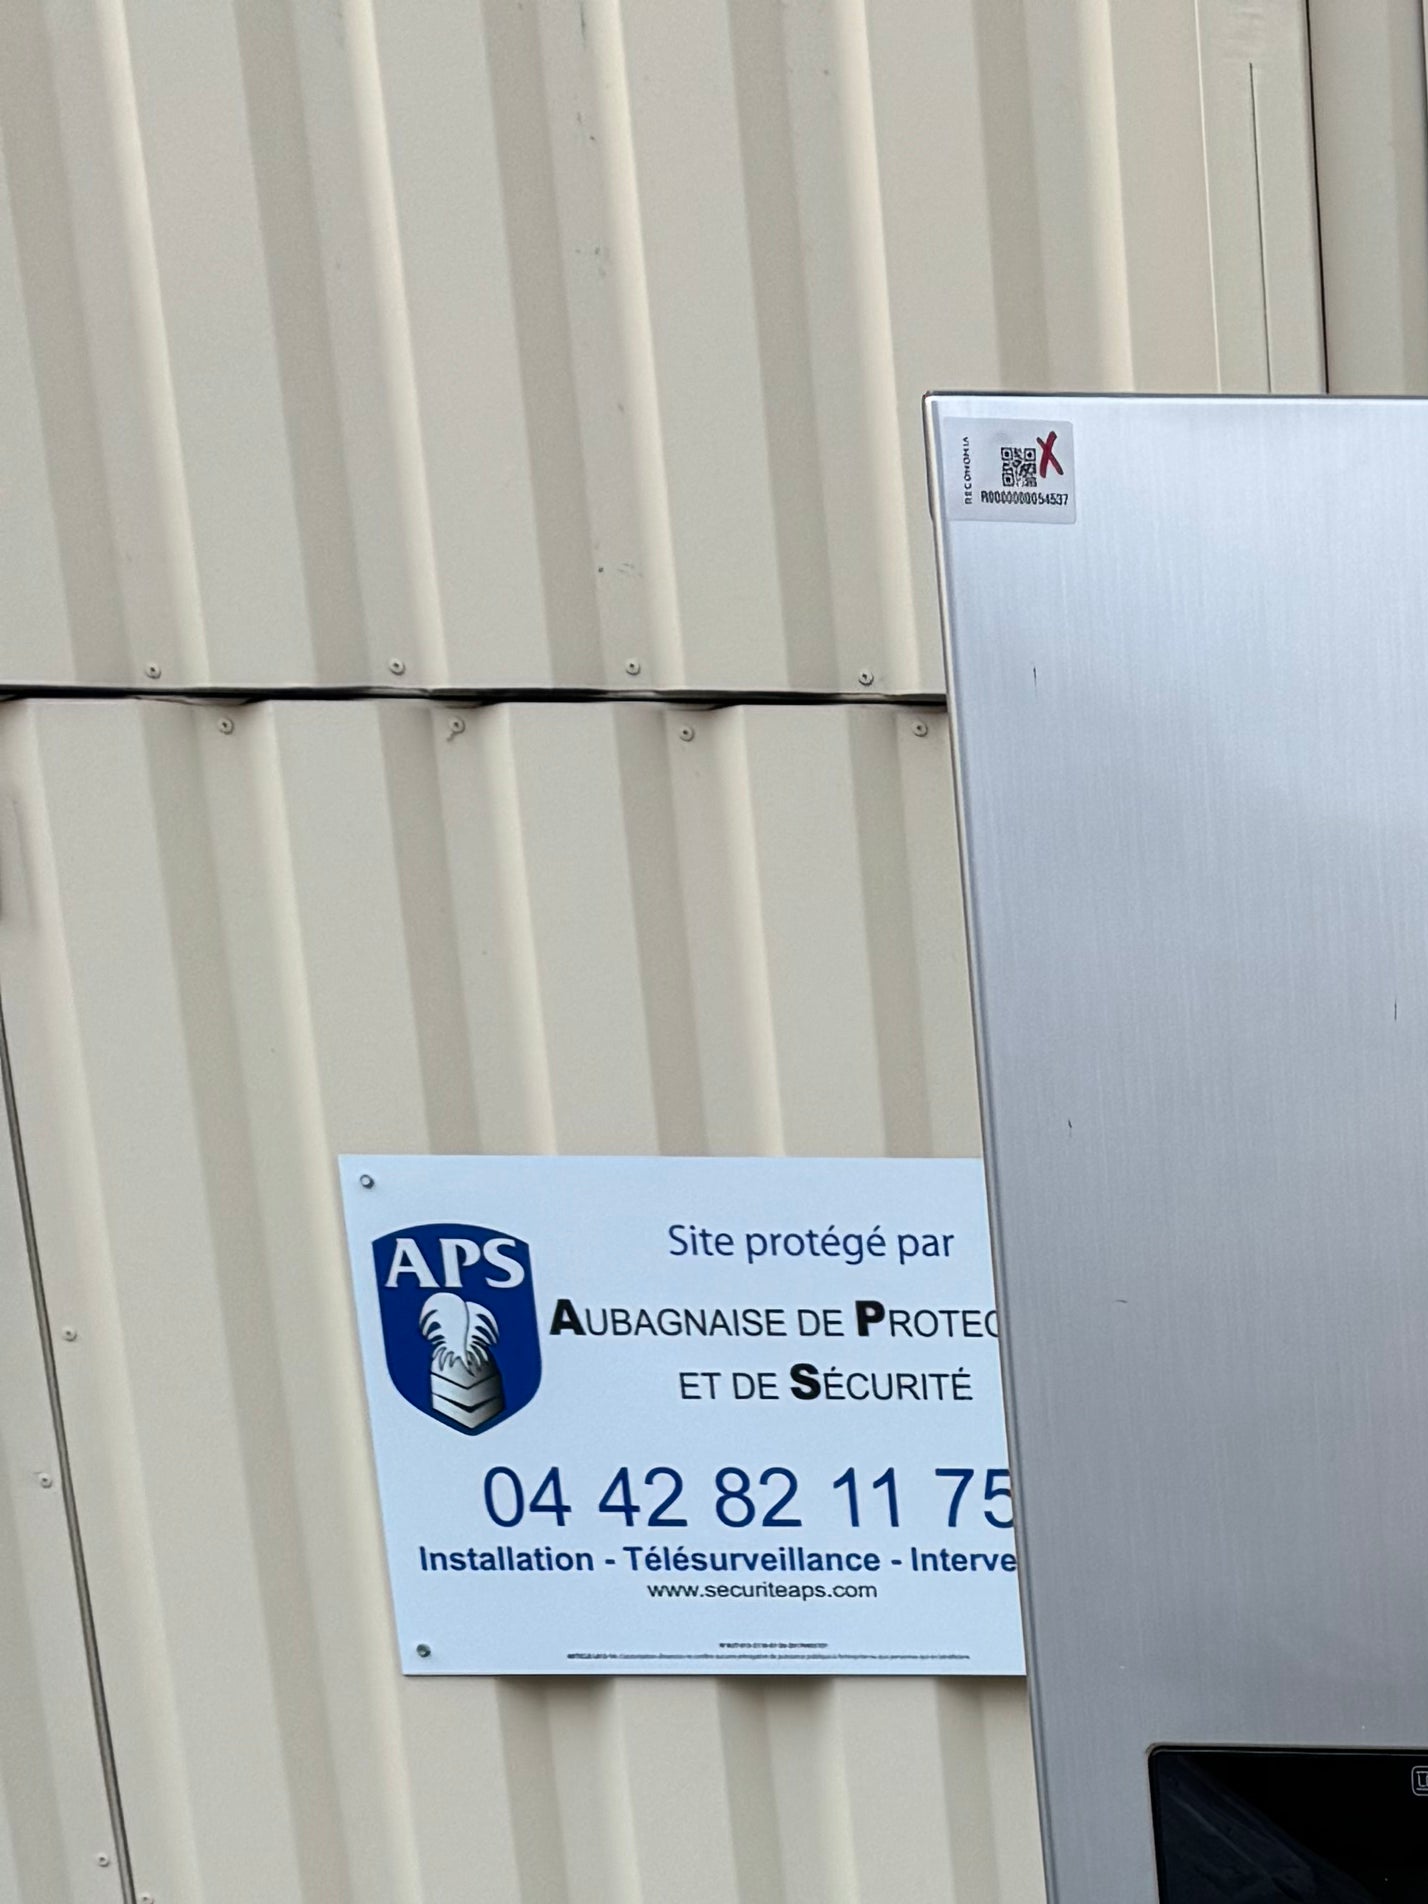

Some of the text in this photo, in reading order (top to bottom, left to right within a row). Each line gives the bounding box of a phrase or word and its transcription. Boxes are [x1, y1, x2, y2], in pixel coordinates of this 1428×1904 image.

[385, 1237, 527, 1289] APS
[668, 1225, 954, 1265] Site protégé par
[797, 1309, 844, 1337] DE
[679, 1363, 973, 1401] ET DE SÉCURITÉ
[484, 1466, 1014, 1529] 04 42 82 11 75
[419, 1546, 594, 1572] Installation
[623, 1545, 881, 1572] Télésurveillance
[911, 1546, 1017, 1572] Interve
[647, 1582, 878, 1600] www.securiteaps.com
